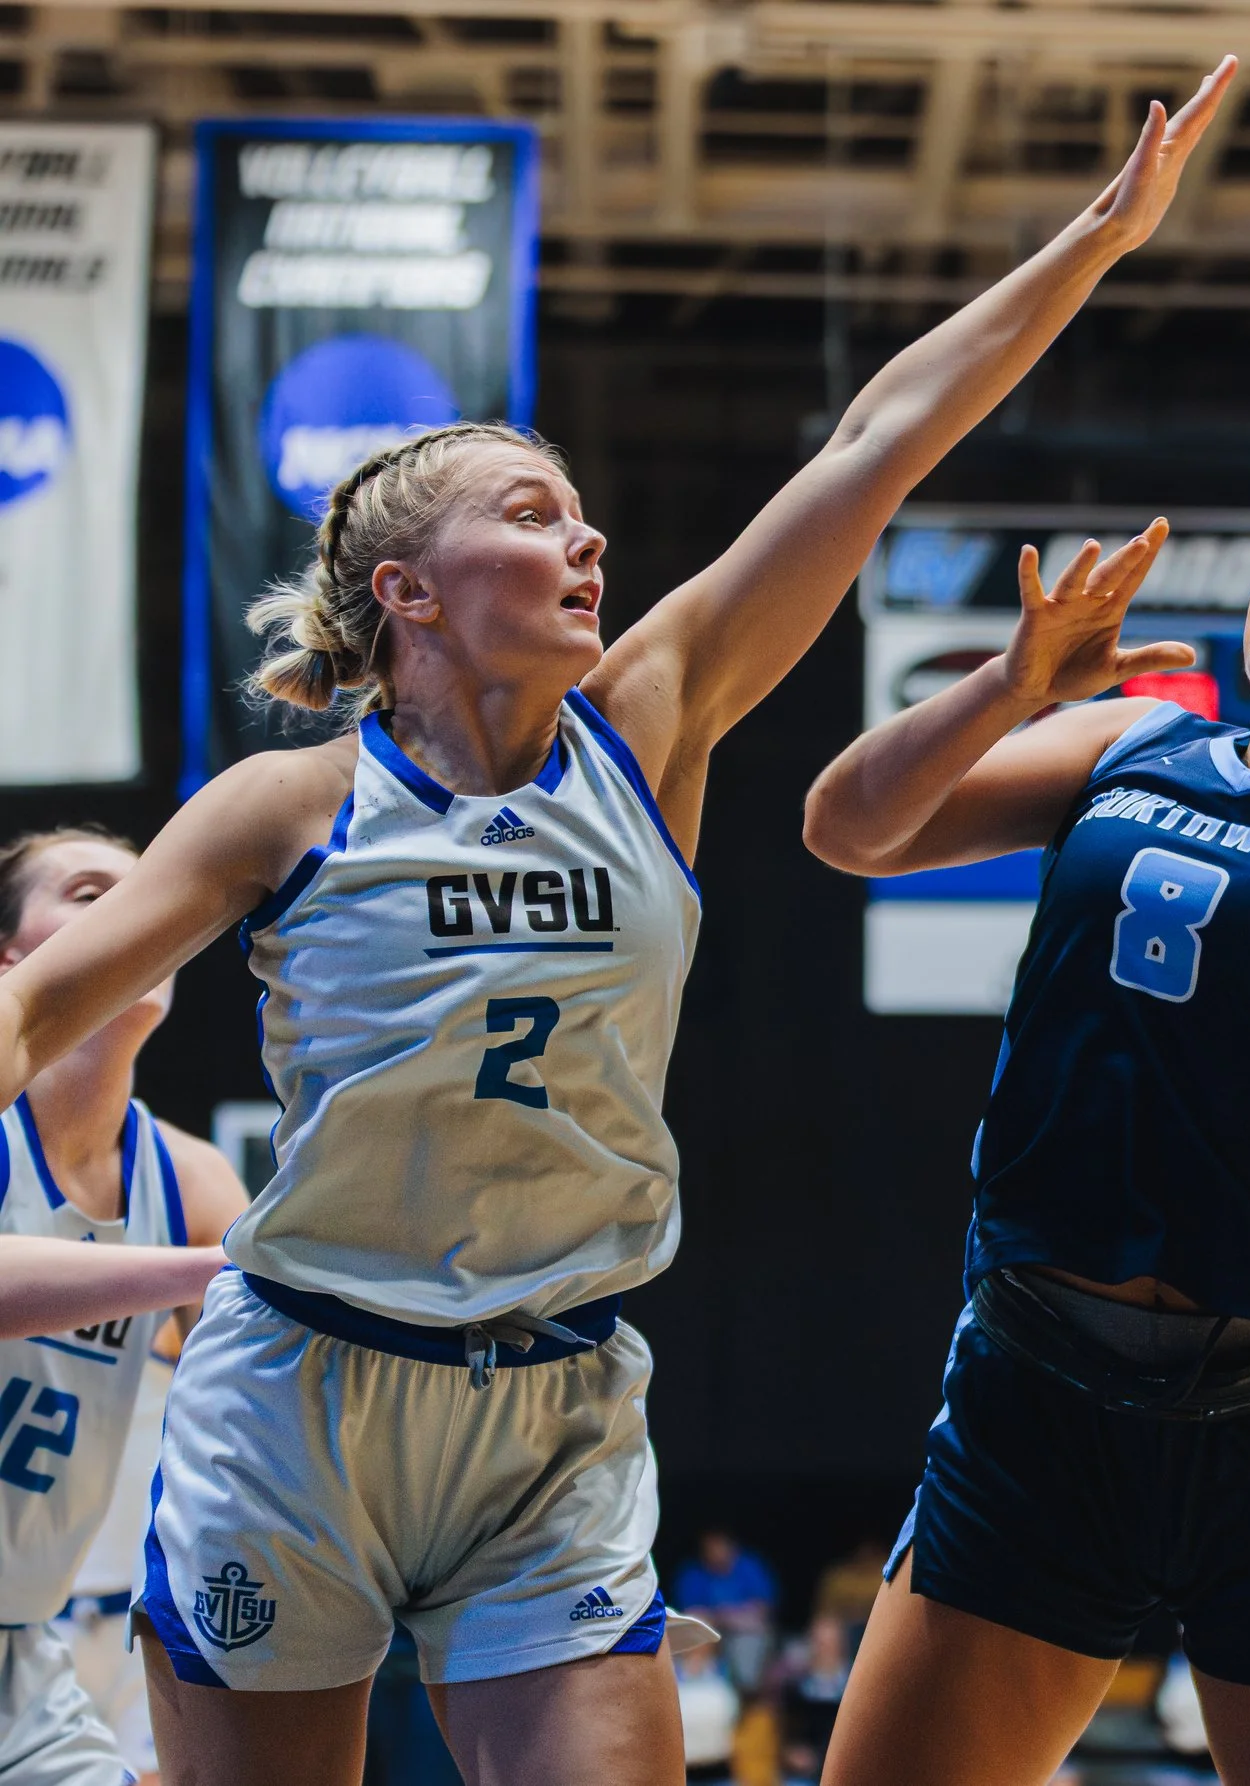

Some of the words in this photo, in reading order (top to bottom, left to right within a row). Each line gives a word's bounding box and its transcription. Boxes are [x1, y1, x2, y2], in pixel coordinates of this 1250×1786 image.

[480, 825, 535, 847] adidas
[426, 867, 614, 938] GVSU
[1109, 847, 1230, 1003] 8
[474, 996, 560, 1110] 2
[569, 1605, 624, 1621] adidas
